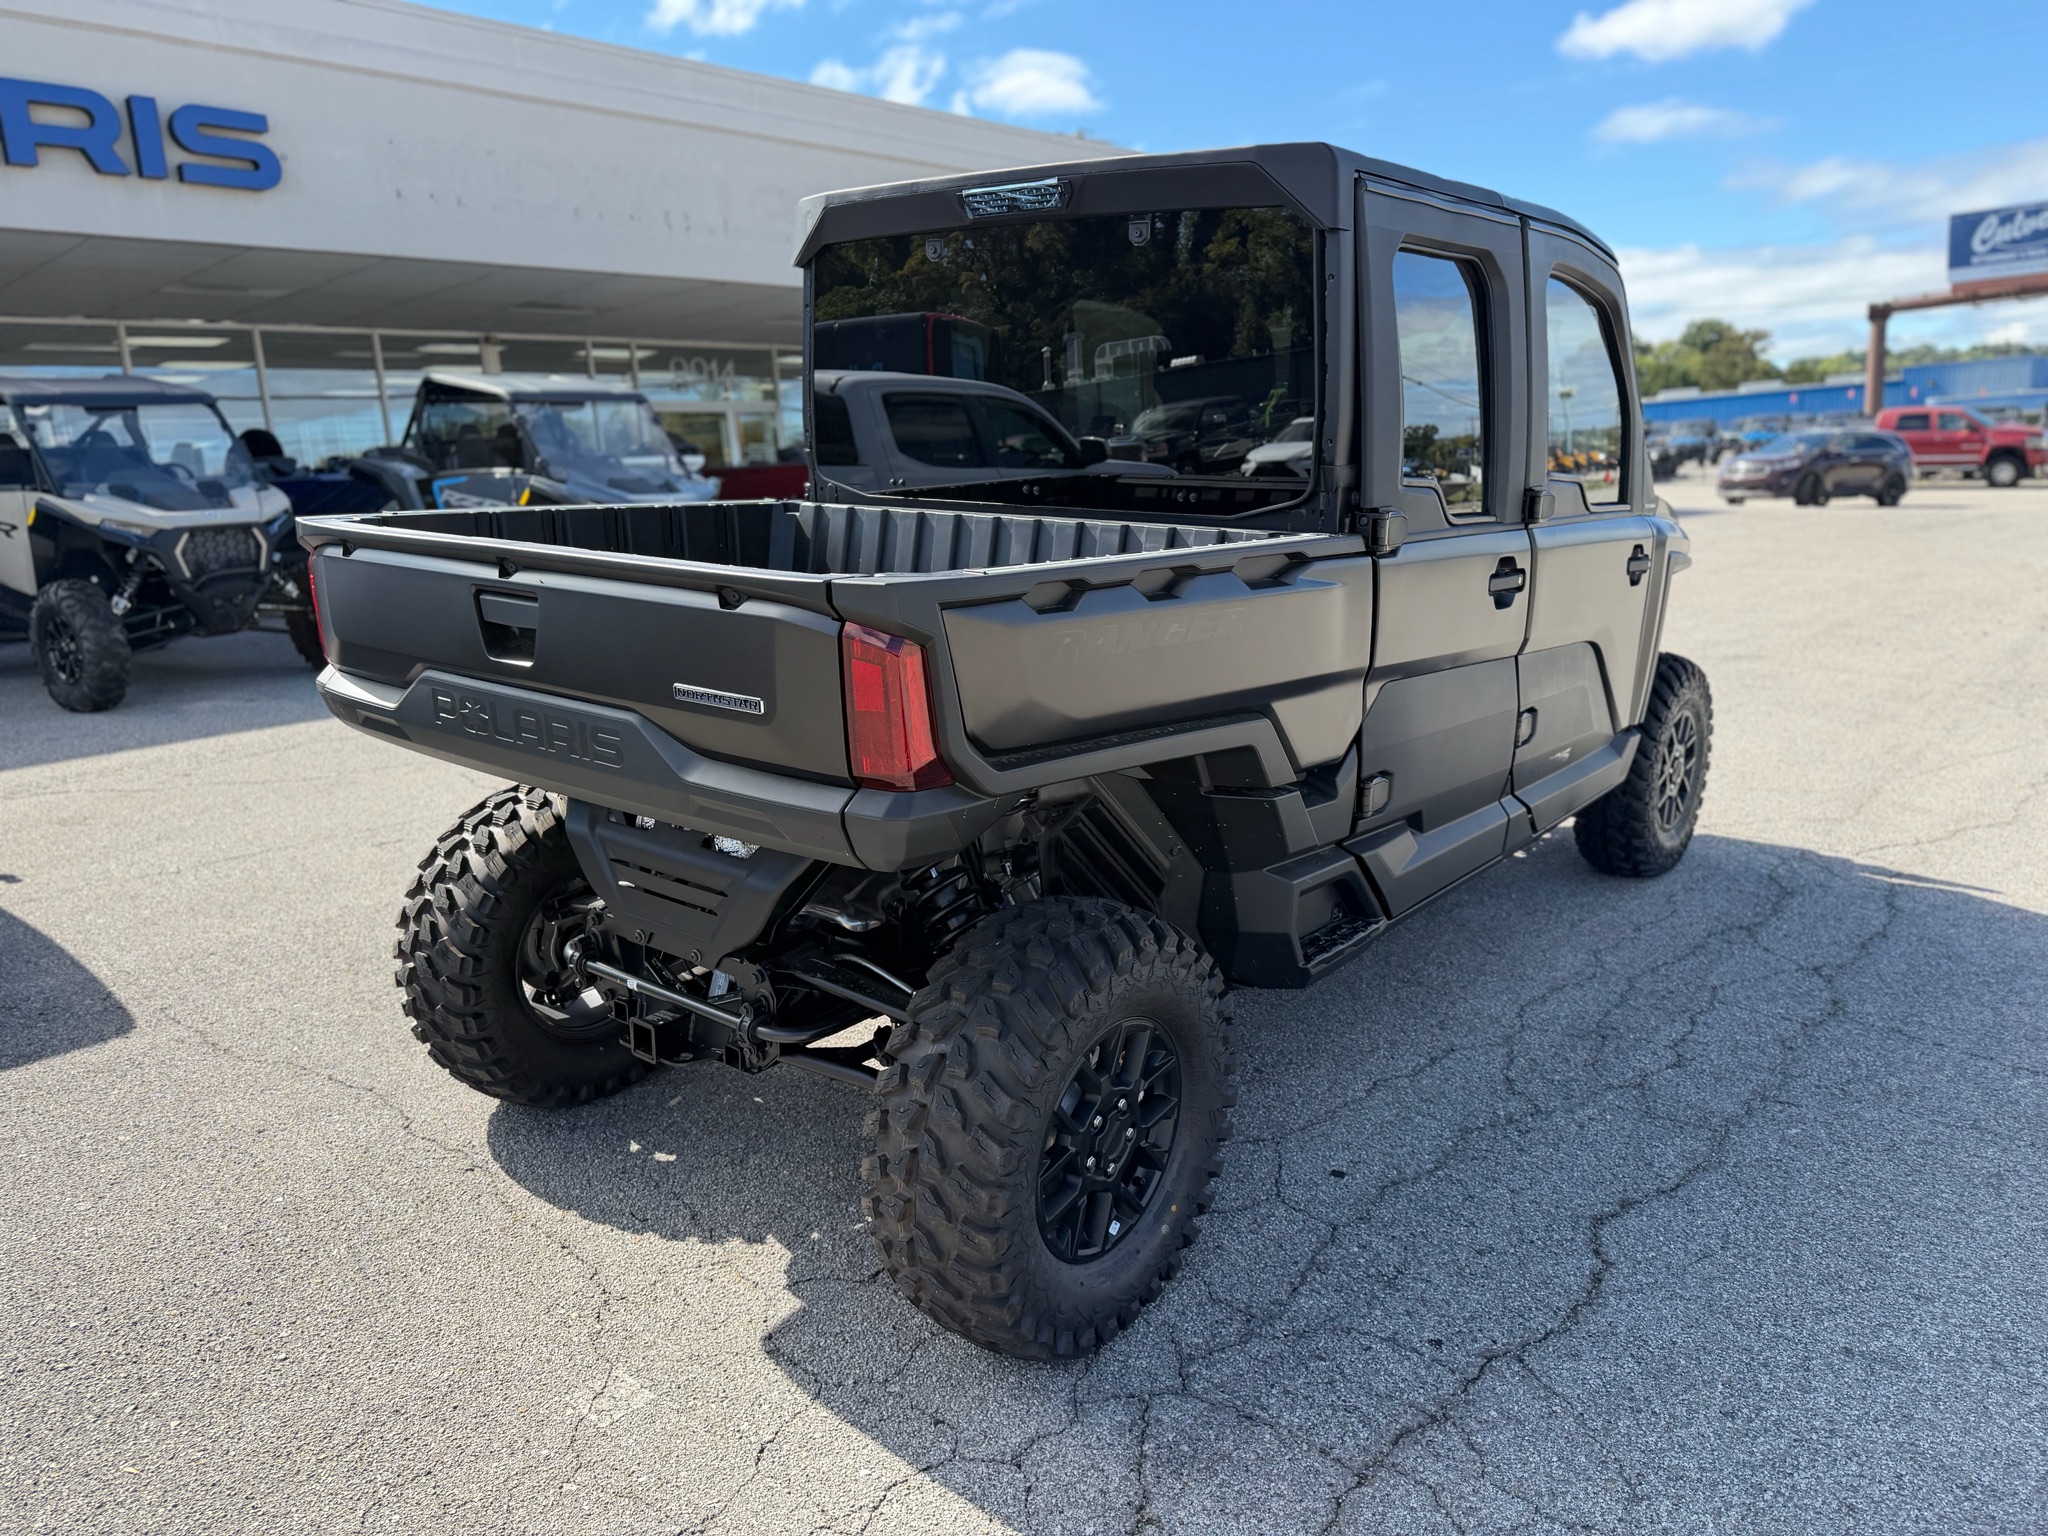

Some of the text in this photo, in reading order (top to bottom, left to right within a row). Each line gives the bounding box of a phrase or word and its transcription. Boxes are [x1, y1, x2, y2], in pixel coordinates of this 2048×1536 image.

[1052, 606, 1250, 663] RANGER
[677, 687, 758, 711] NORTHSTAR
[431, 687, 625, 769] POLARIS
